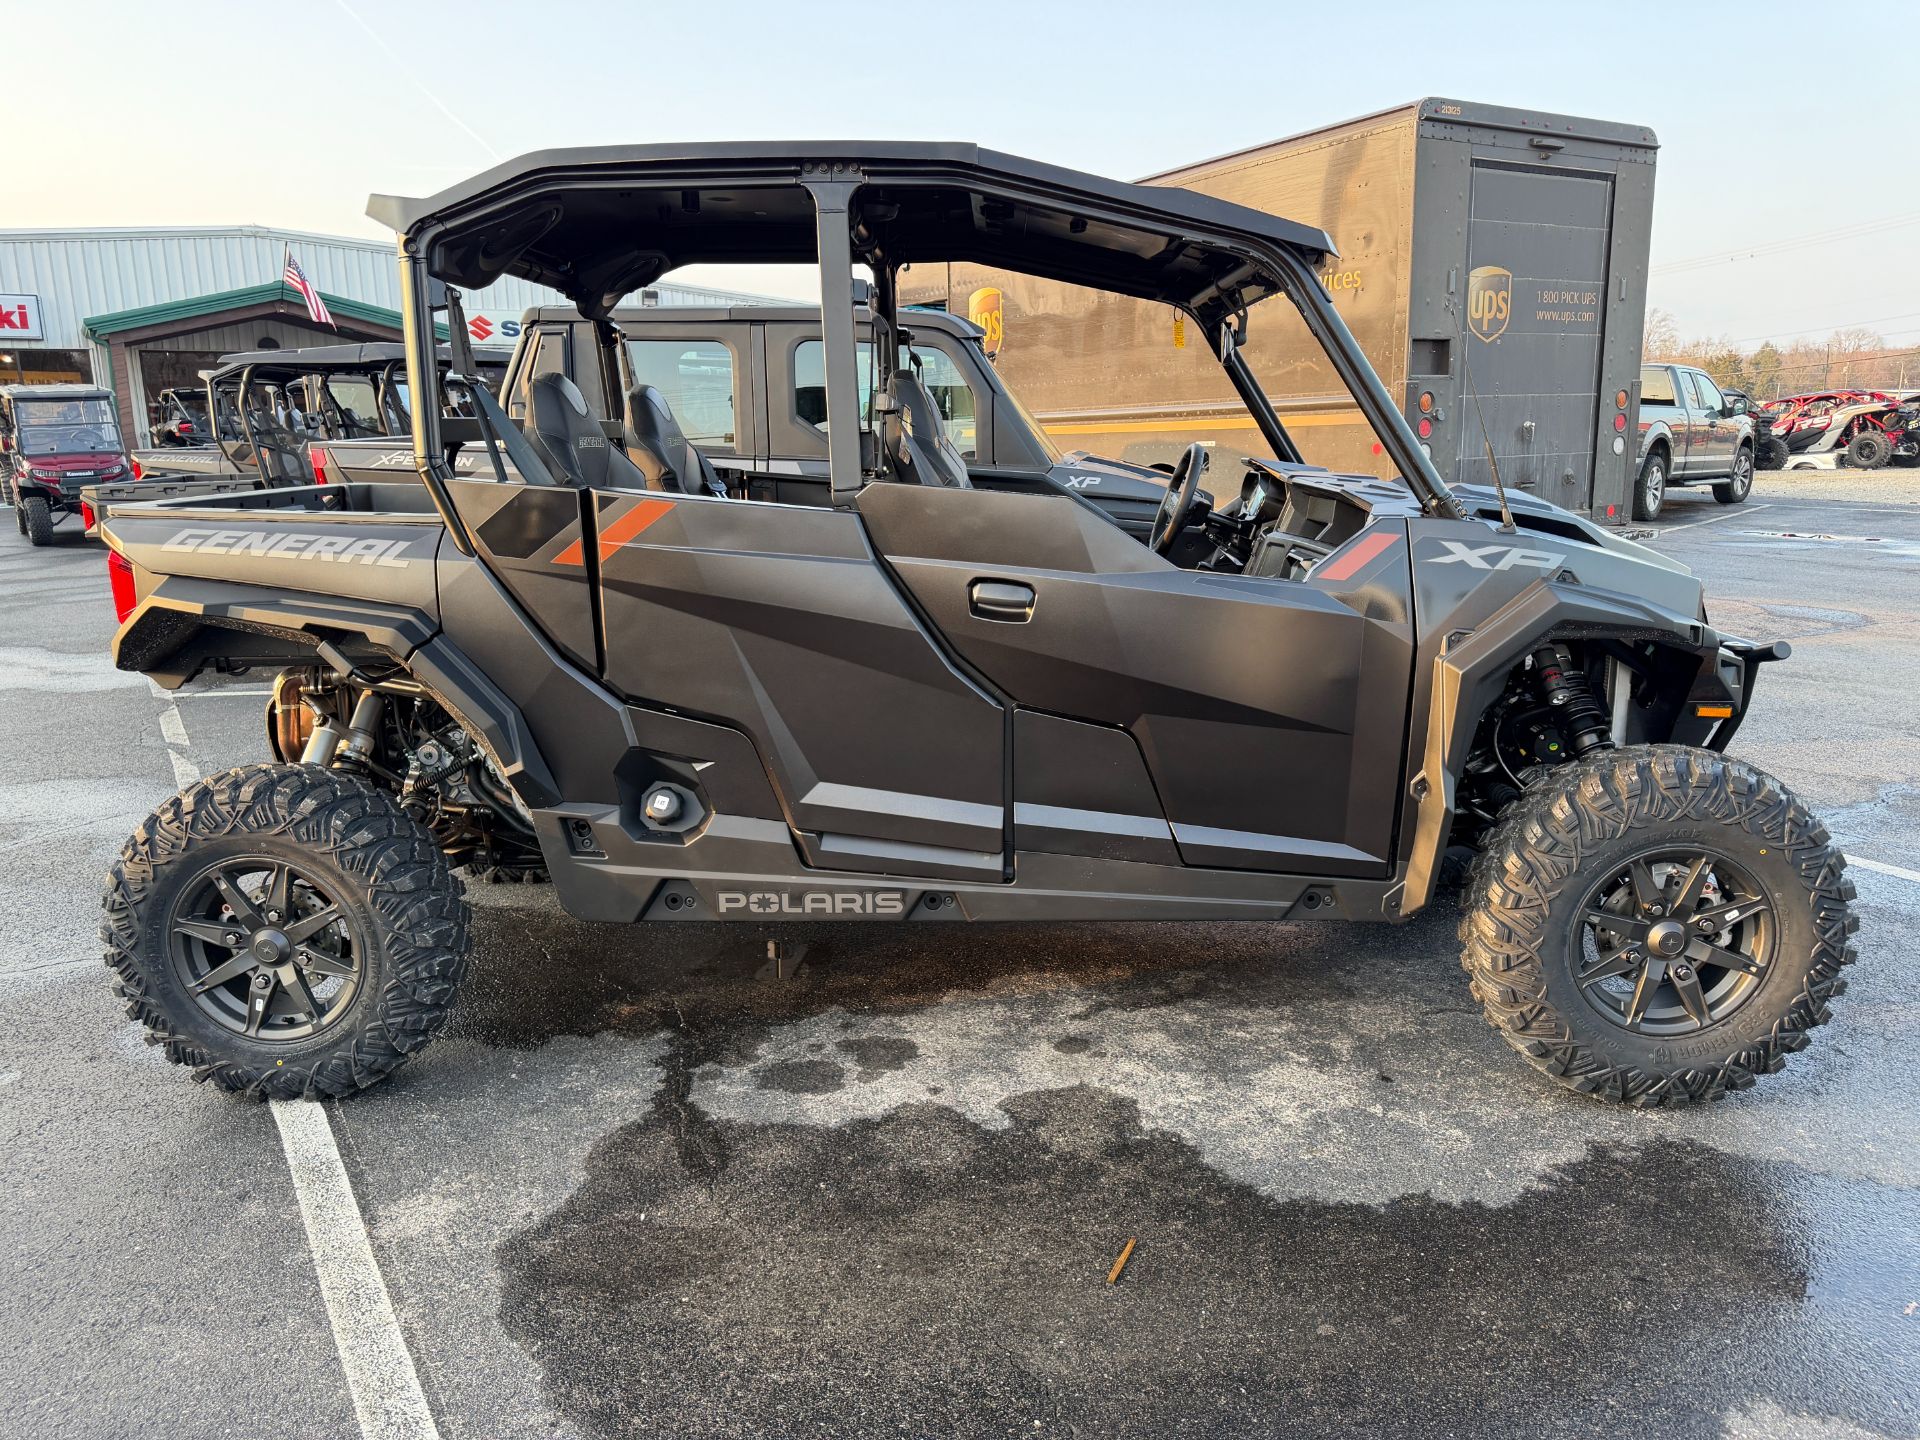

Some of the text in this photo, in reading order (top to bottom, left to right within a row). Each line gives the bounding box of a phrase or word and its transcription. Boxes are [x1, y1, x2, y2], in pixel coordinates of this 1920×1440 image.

[1317, 268, 1361, 291] vices
[1543, 291, 1559, 303] 800
[1561, 291, 1580, 304] PICK
[1581, 292, 1596, 305] UPS
[1471, 290, 1508, 331] ups
[1536, 310, 1595, 324] www.ups.com
[149, 454, 213, 464] GENERAL
[1063, 475, 1102, 488] XP
[160, 528, 412, 568] GENERAL
[1421, 540, 1567, 571] XP
[718, 892, 904, 914] POLARIS
